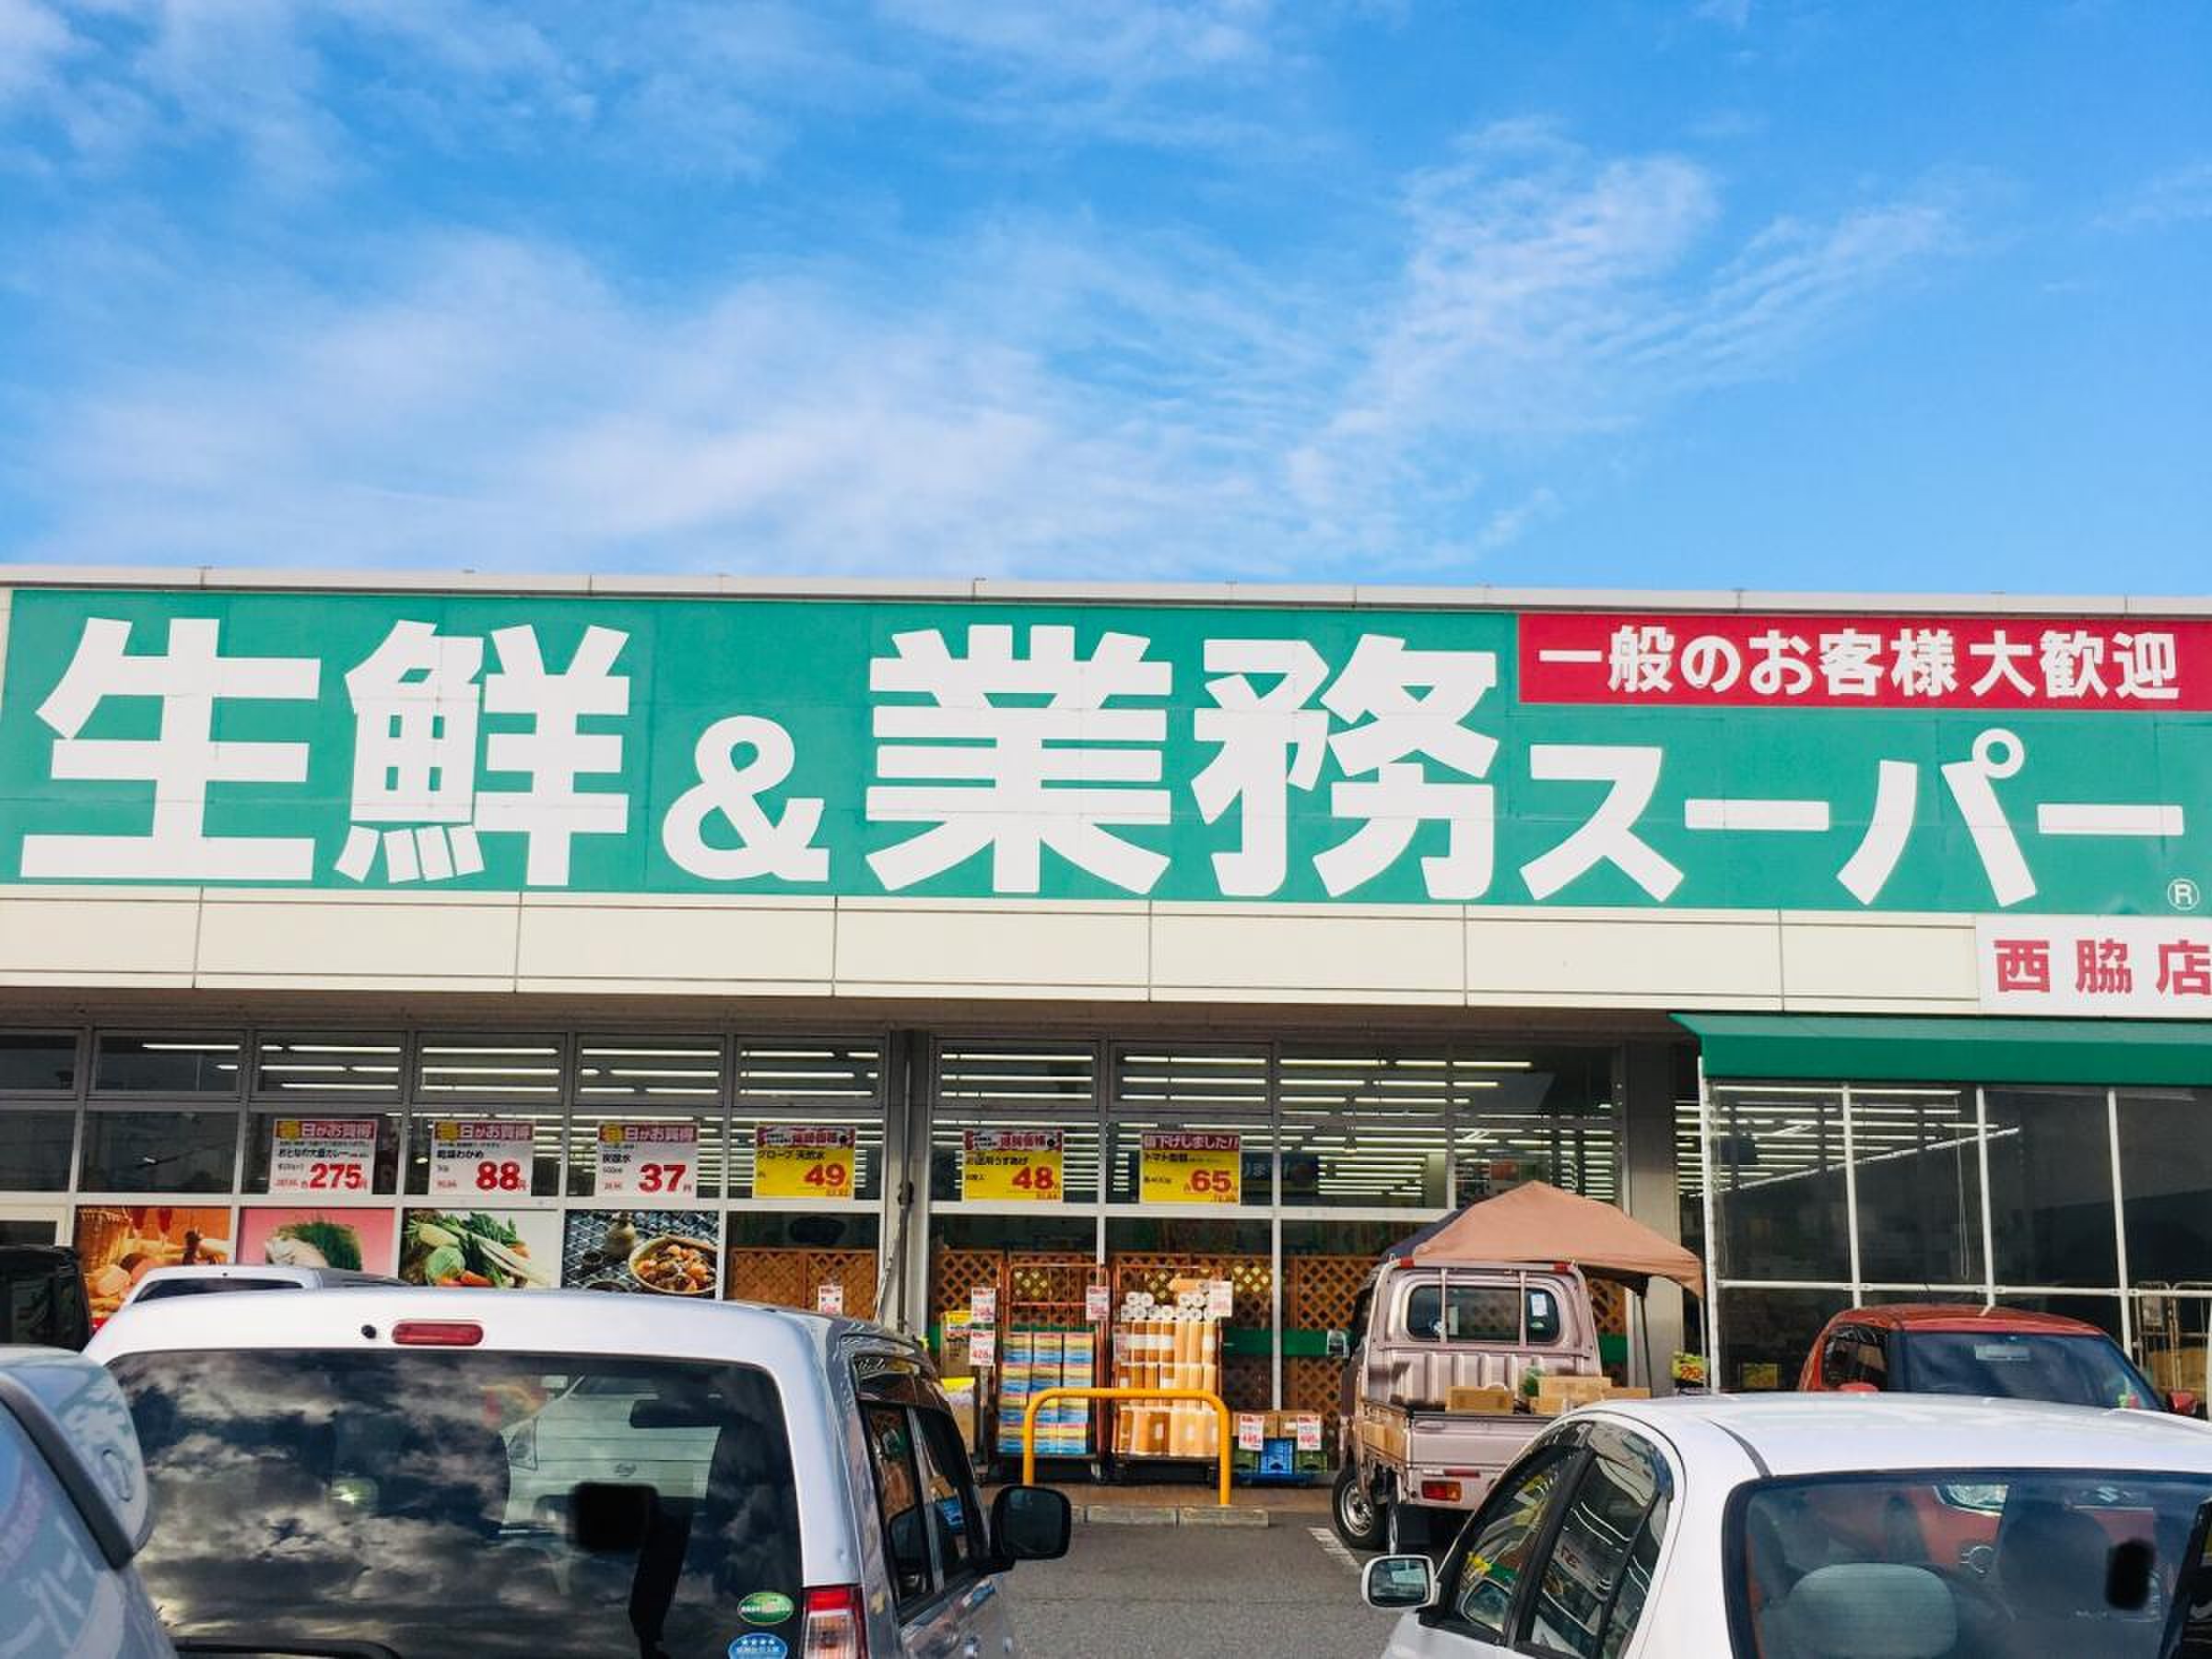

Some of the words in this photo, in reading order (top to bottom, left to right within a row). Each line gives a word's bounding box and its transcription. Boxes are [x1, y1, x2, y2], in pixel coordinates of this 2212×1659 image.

[1538, 627, 2181, 699] 一般のお客様大歓迎
[1994, 938, 2211, 994] 西脇店
